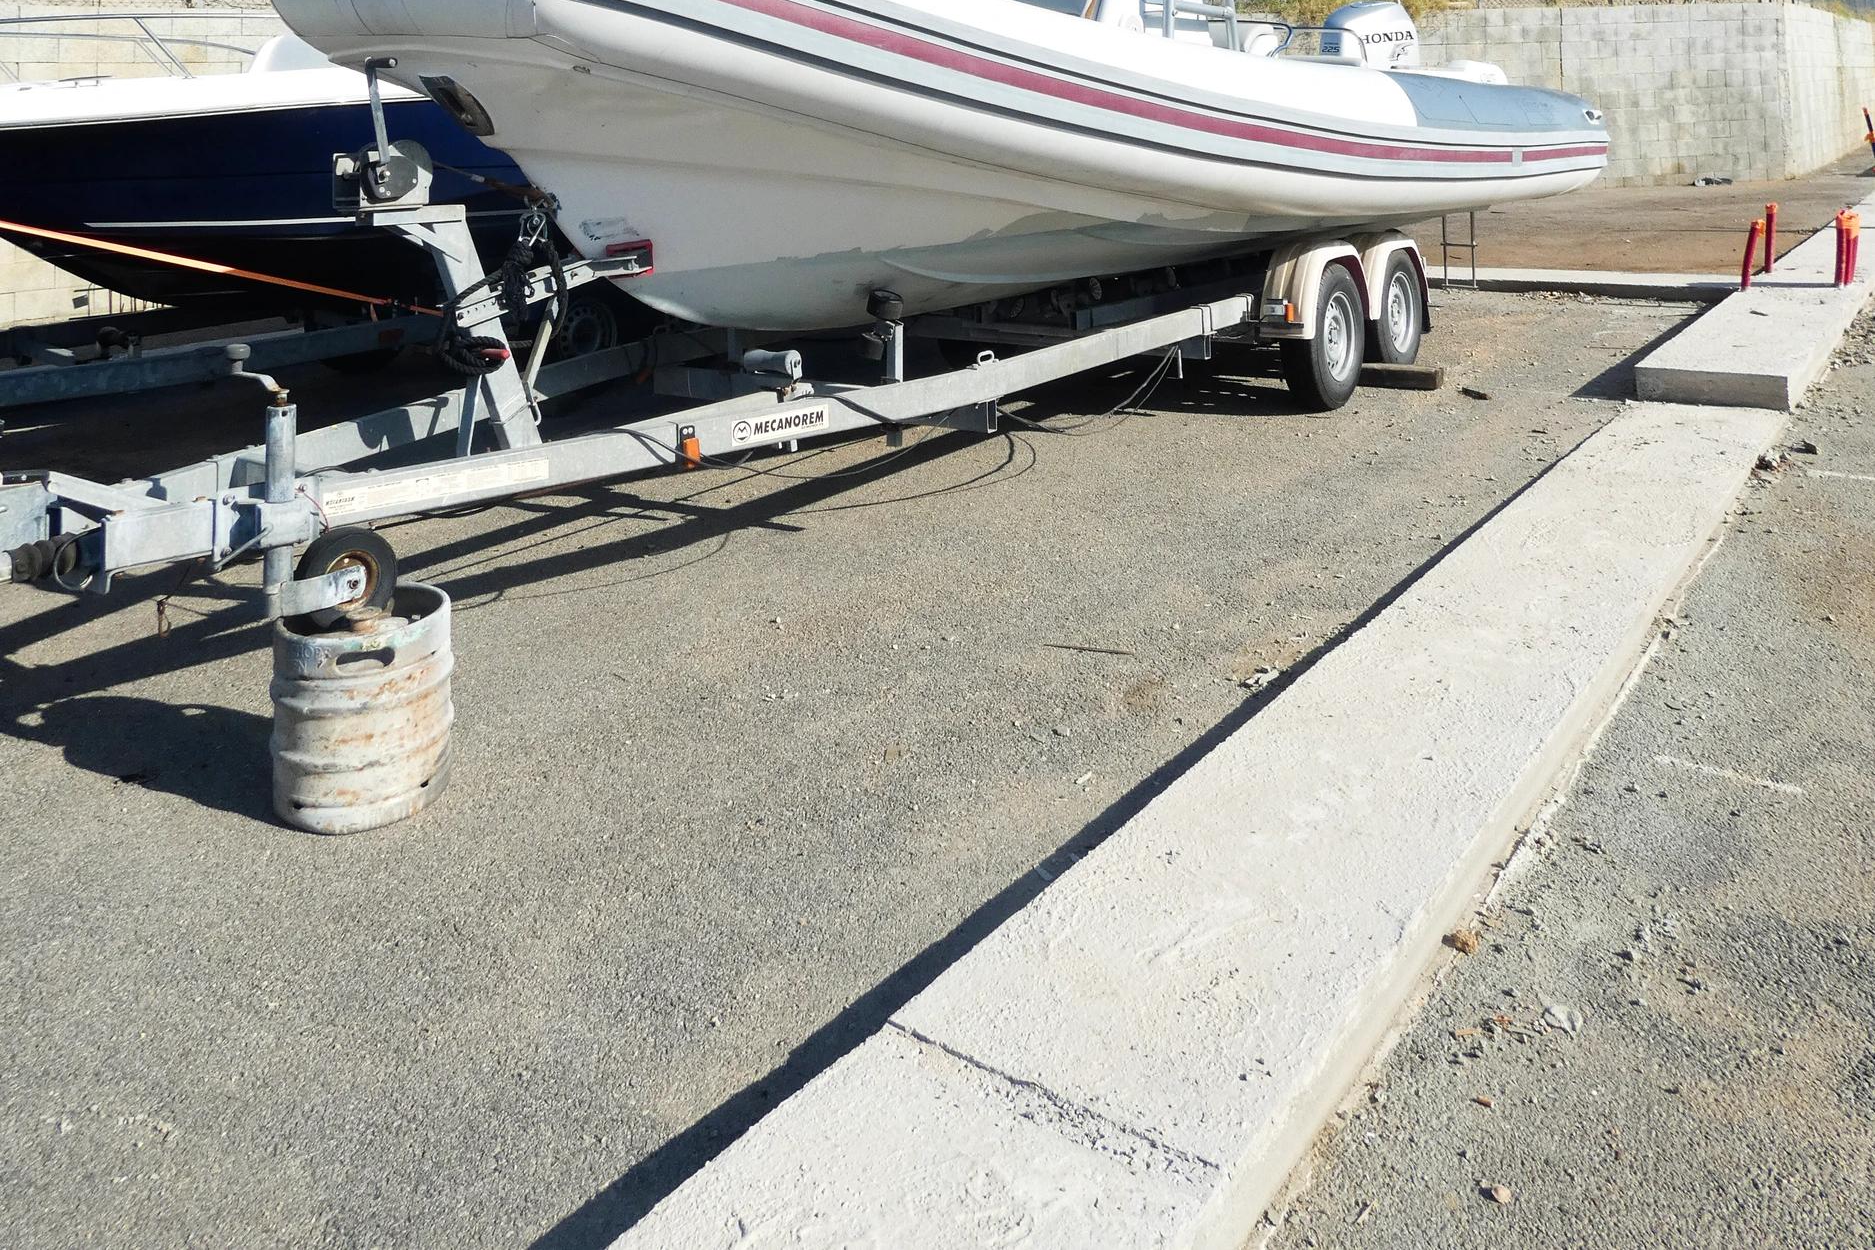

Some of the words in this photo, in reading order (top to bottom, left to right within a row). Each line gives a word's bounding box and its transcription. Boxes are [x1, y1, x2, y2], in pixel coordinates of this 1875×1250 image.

[1362, 31, 1414, 44] HONDA
[1321, 45, 1340, 53] 225
[753, 410, 824, 436] MECANOREM
